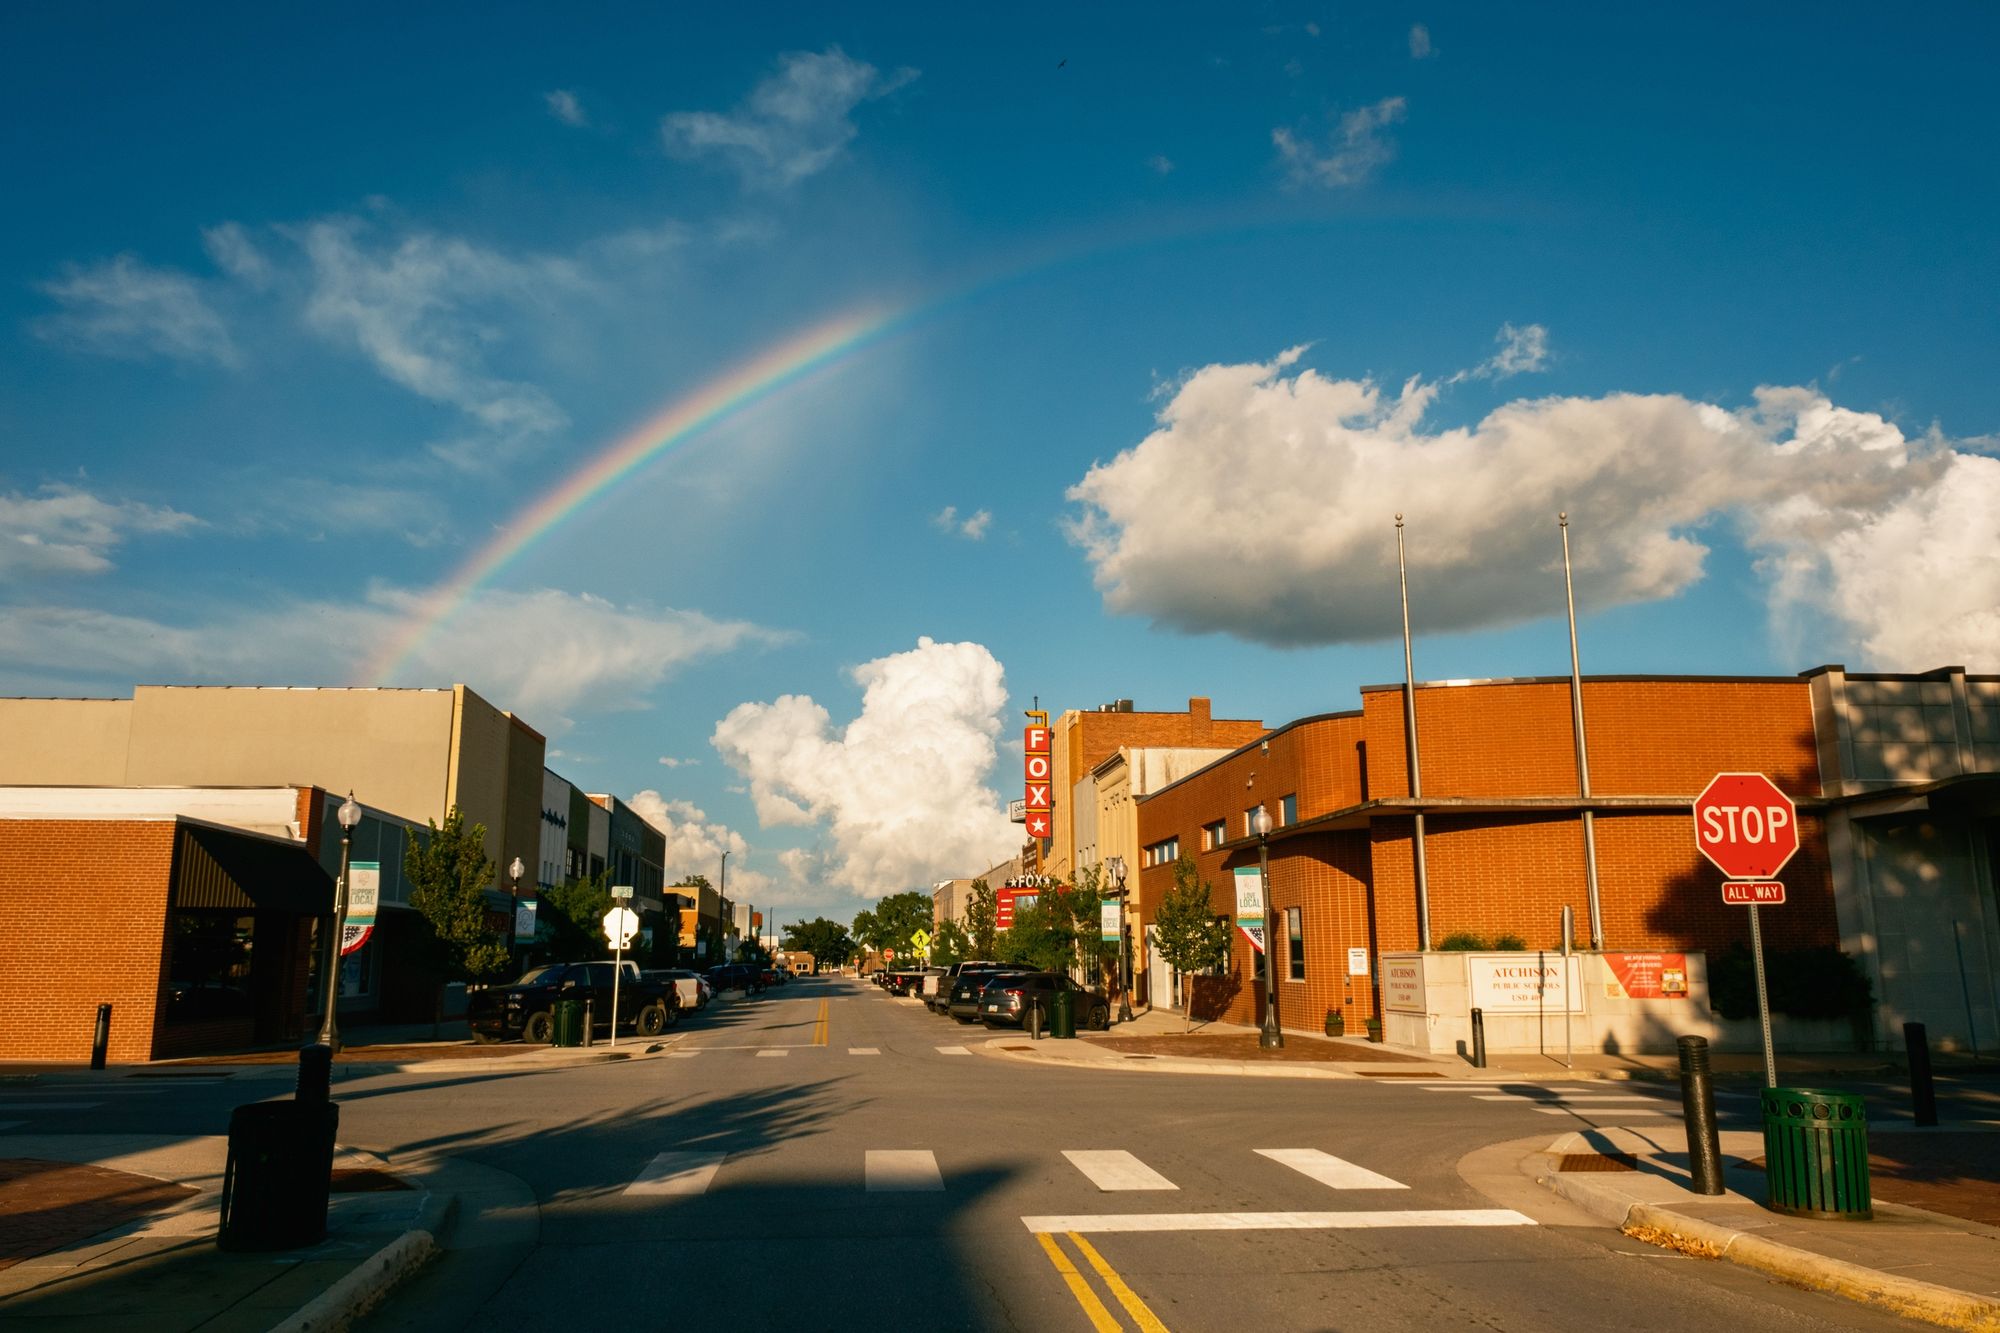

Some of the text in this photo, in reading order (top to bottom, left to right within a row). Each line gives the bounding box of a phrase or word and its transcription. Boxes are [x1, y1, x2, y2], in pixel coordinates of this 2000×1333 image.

[1028, 730, 1047, 806] FOX
[1703, 805, 1788, 844] STOP
[1018, 874, 1043, 888] FOX
[1728, 886, 1778, 899] ALL WAY
[350, 895, 375, 904] LOCAL
[1239, 899, 1261, 908] LOCAL
[1493, 967, 1558, 978] ATCHISON
